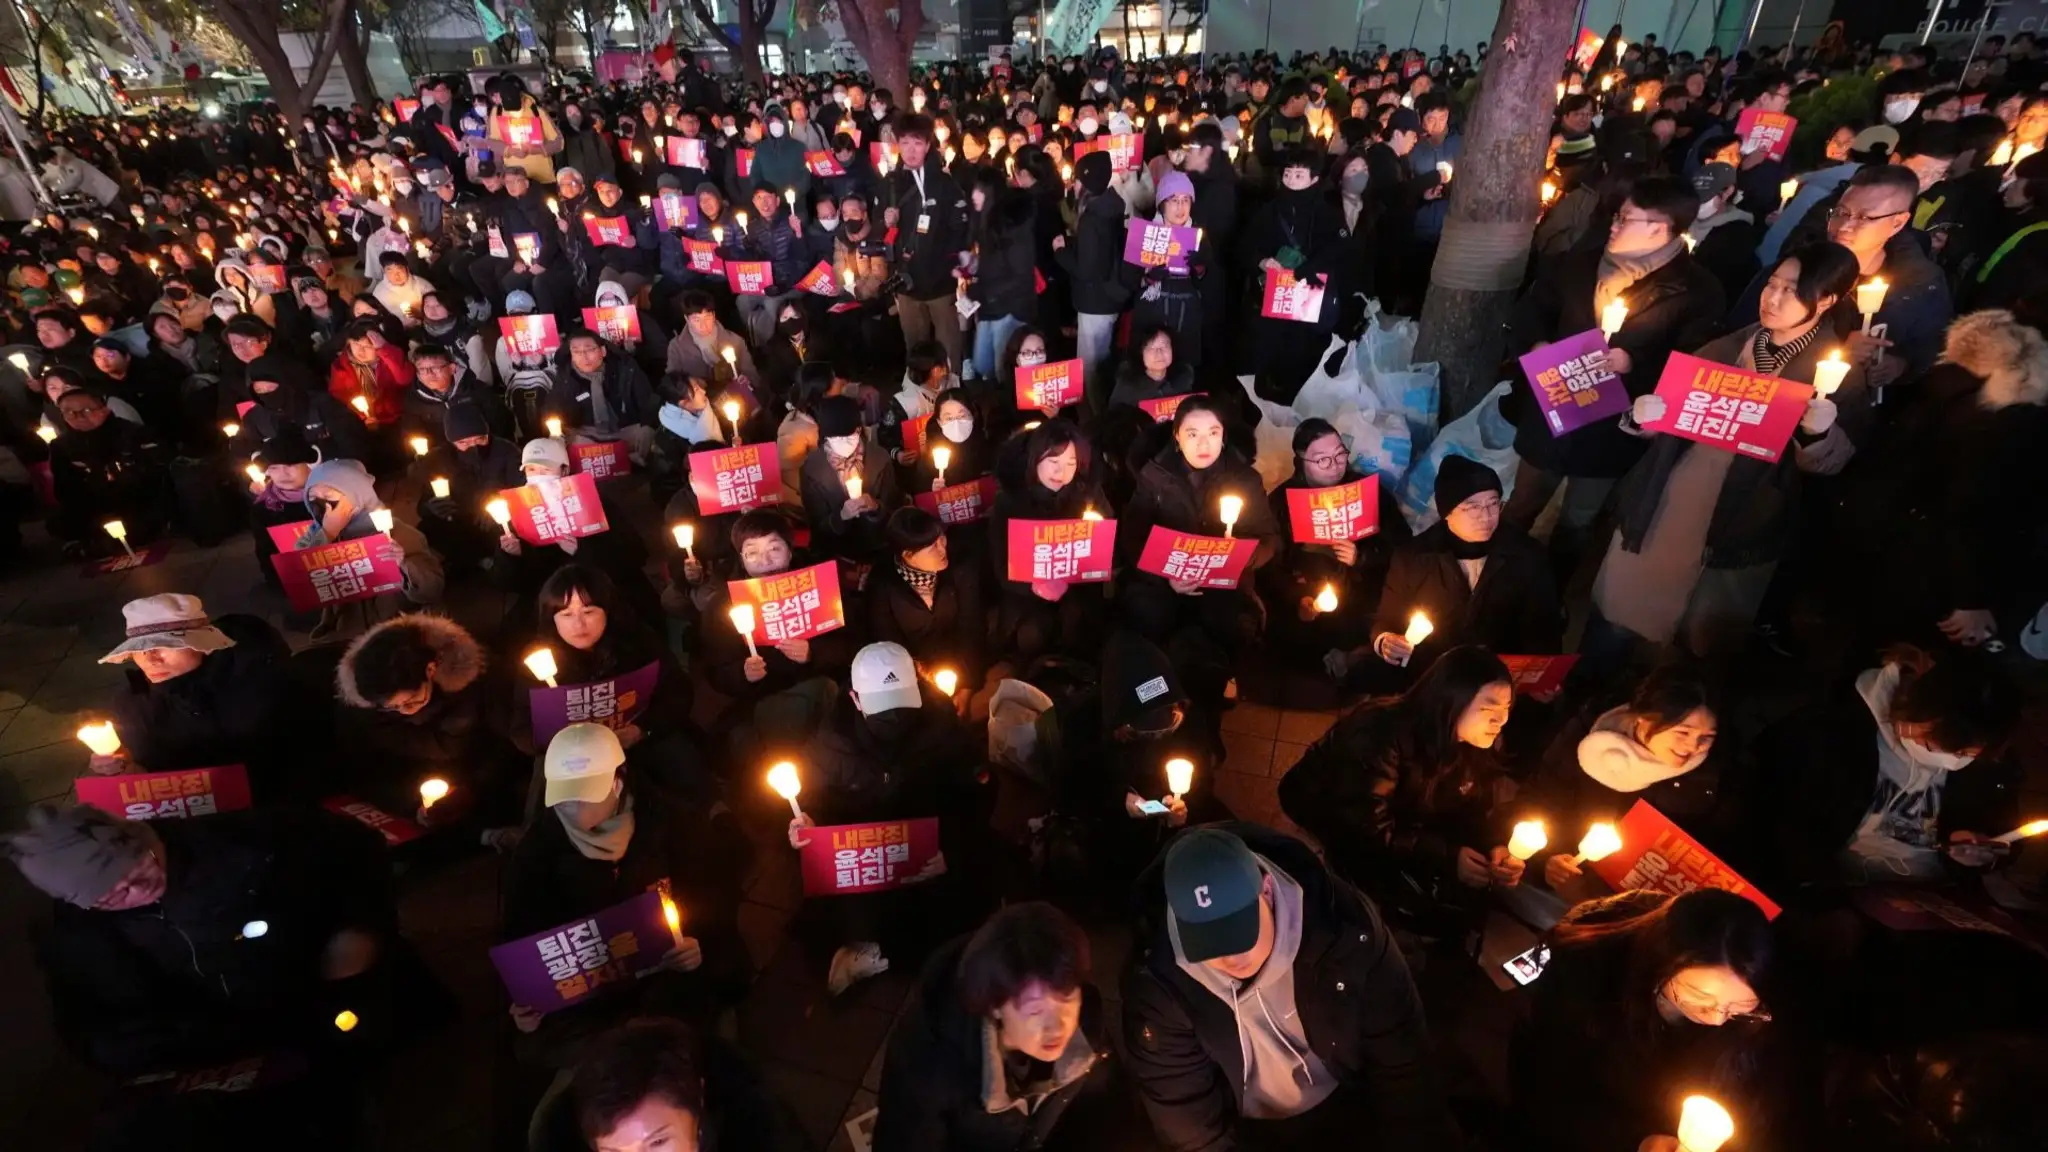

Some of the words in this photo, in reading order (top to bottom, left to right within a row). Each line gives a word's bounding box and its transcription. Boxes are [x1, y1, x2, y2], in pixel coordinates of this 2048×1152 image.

[1032, 363, 1068, 382] 내란죄
[1033, 376, 1069, 393] 윤석열
[1558, 361, 1601, 408] 광장을
[1692, 366, 1782, 403] 내란죄
[1535, 366, 1568, 409] 열자!
[1680, 391, 1769, 426] 윤석열
[1674, 409, 1741, 442] 퇴진!
[712, 447, 759, 472] 내란죄
[716, 464, 763, 489] 윤석열
[719, 484, 757, 507] 퇴진!
[938, 494, 982, 514] 윤석열
[1309, 480, 1361, 509] 내란죄
[941, 508, 976, 523] 퇴진!
[1312, 500, 1362, 525] 윤석열
[1033, 519, 1095, 545] 내란죄
[1313, 519, 1355, 540] 퇴진!
[301, 542, 367, 571] 내란죄
[1033, 539, 1091, 564] 윤석열
[1168, 550, 1228, 568] 윤석열
[1173, 536, 1236, 556] 내란죄
[309, 557, 374, 589] 윤석열
[1033, 558, 1079, 580] 퇴진!
[1161, 561, 1211, 580] 퇴진!
[316, 576, 368, 604] 퇴진!
[758, 570, 817, 601] 내란죄
[761, 588, 821, 623] 윤석열
[767, 612, 813, 641] 퇴진!
[565, 681, 616, 706] 퇴진
[119, 771, 211, 804] 내란죄
[125, 795, 218, 821] 윤석열
[832, 824, 908, 850] 내란죄
[835, 843, 909, 869] 윤석열
[836, 864, 893, 888] 퇴진!
[1194, 885, 1212, 908] C
[535, 919, 601, 960] 퇴진
[545, 931, 640, 980] 광장을
